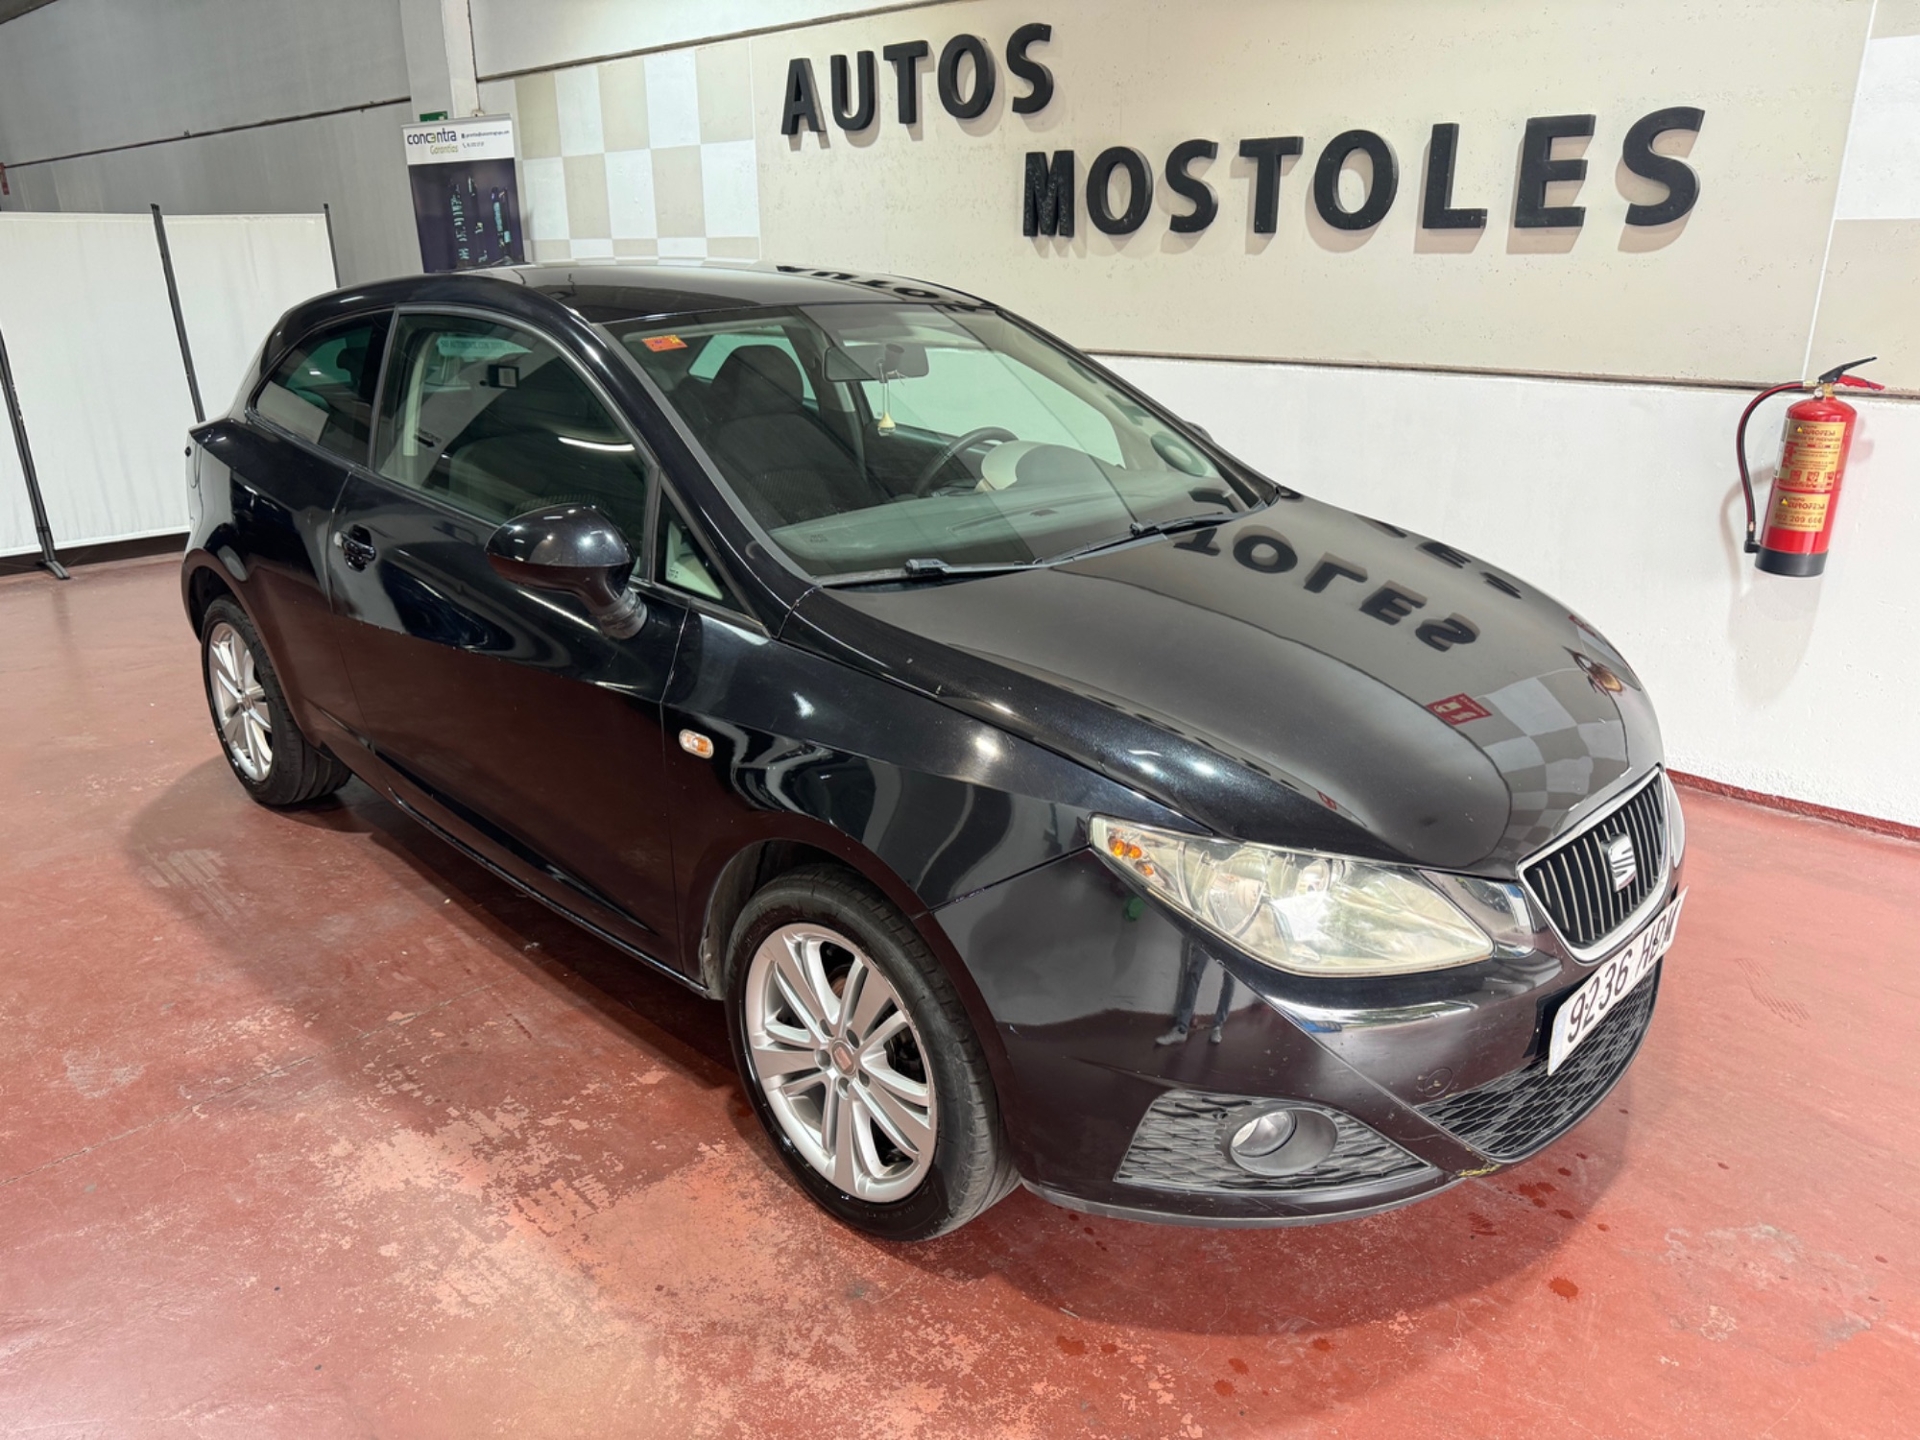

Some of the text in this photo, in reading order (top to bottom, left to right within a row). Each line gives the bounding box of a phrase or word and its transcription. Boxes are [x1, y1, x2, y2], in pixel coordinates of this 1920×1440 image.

[781, 23, 1054, 135] AUTOS
[1023, 106, 1705, 237] MOSTOLES
[1567, 948, 1633, 1043] 9236
